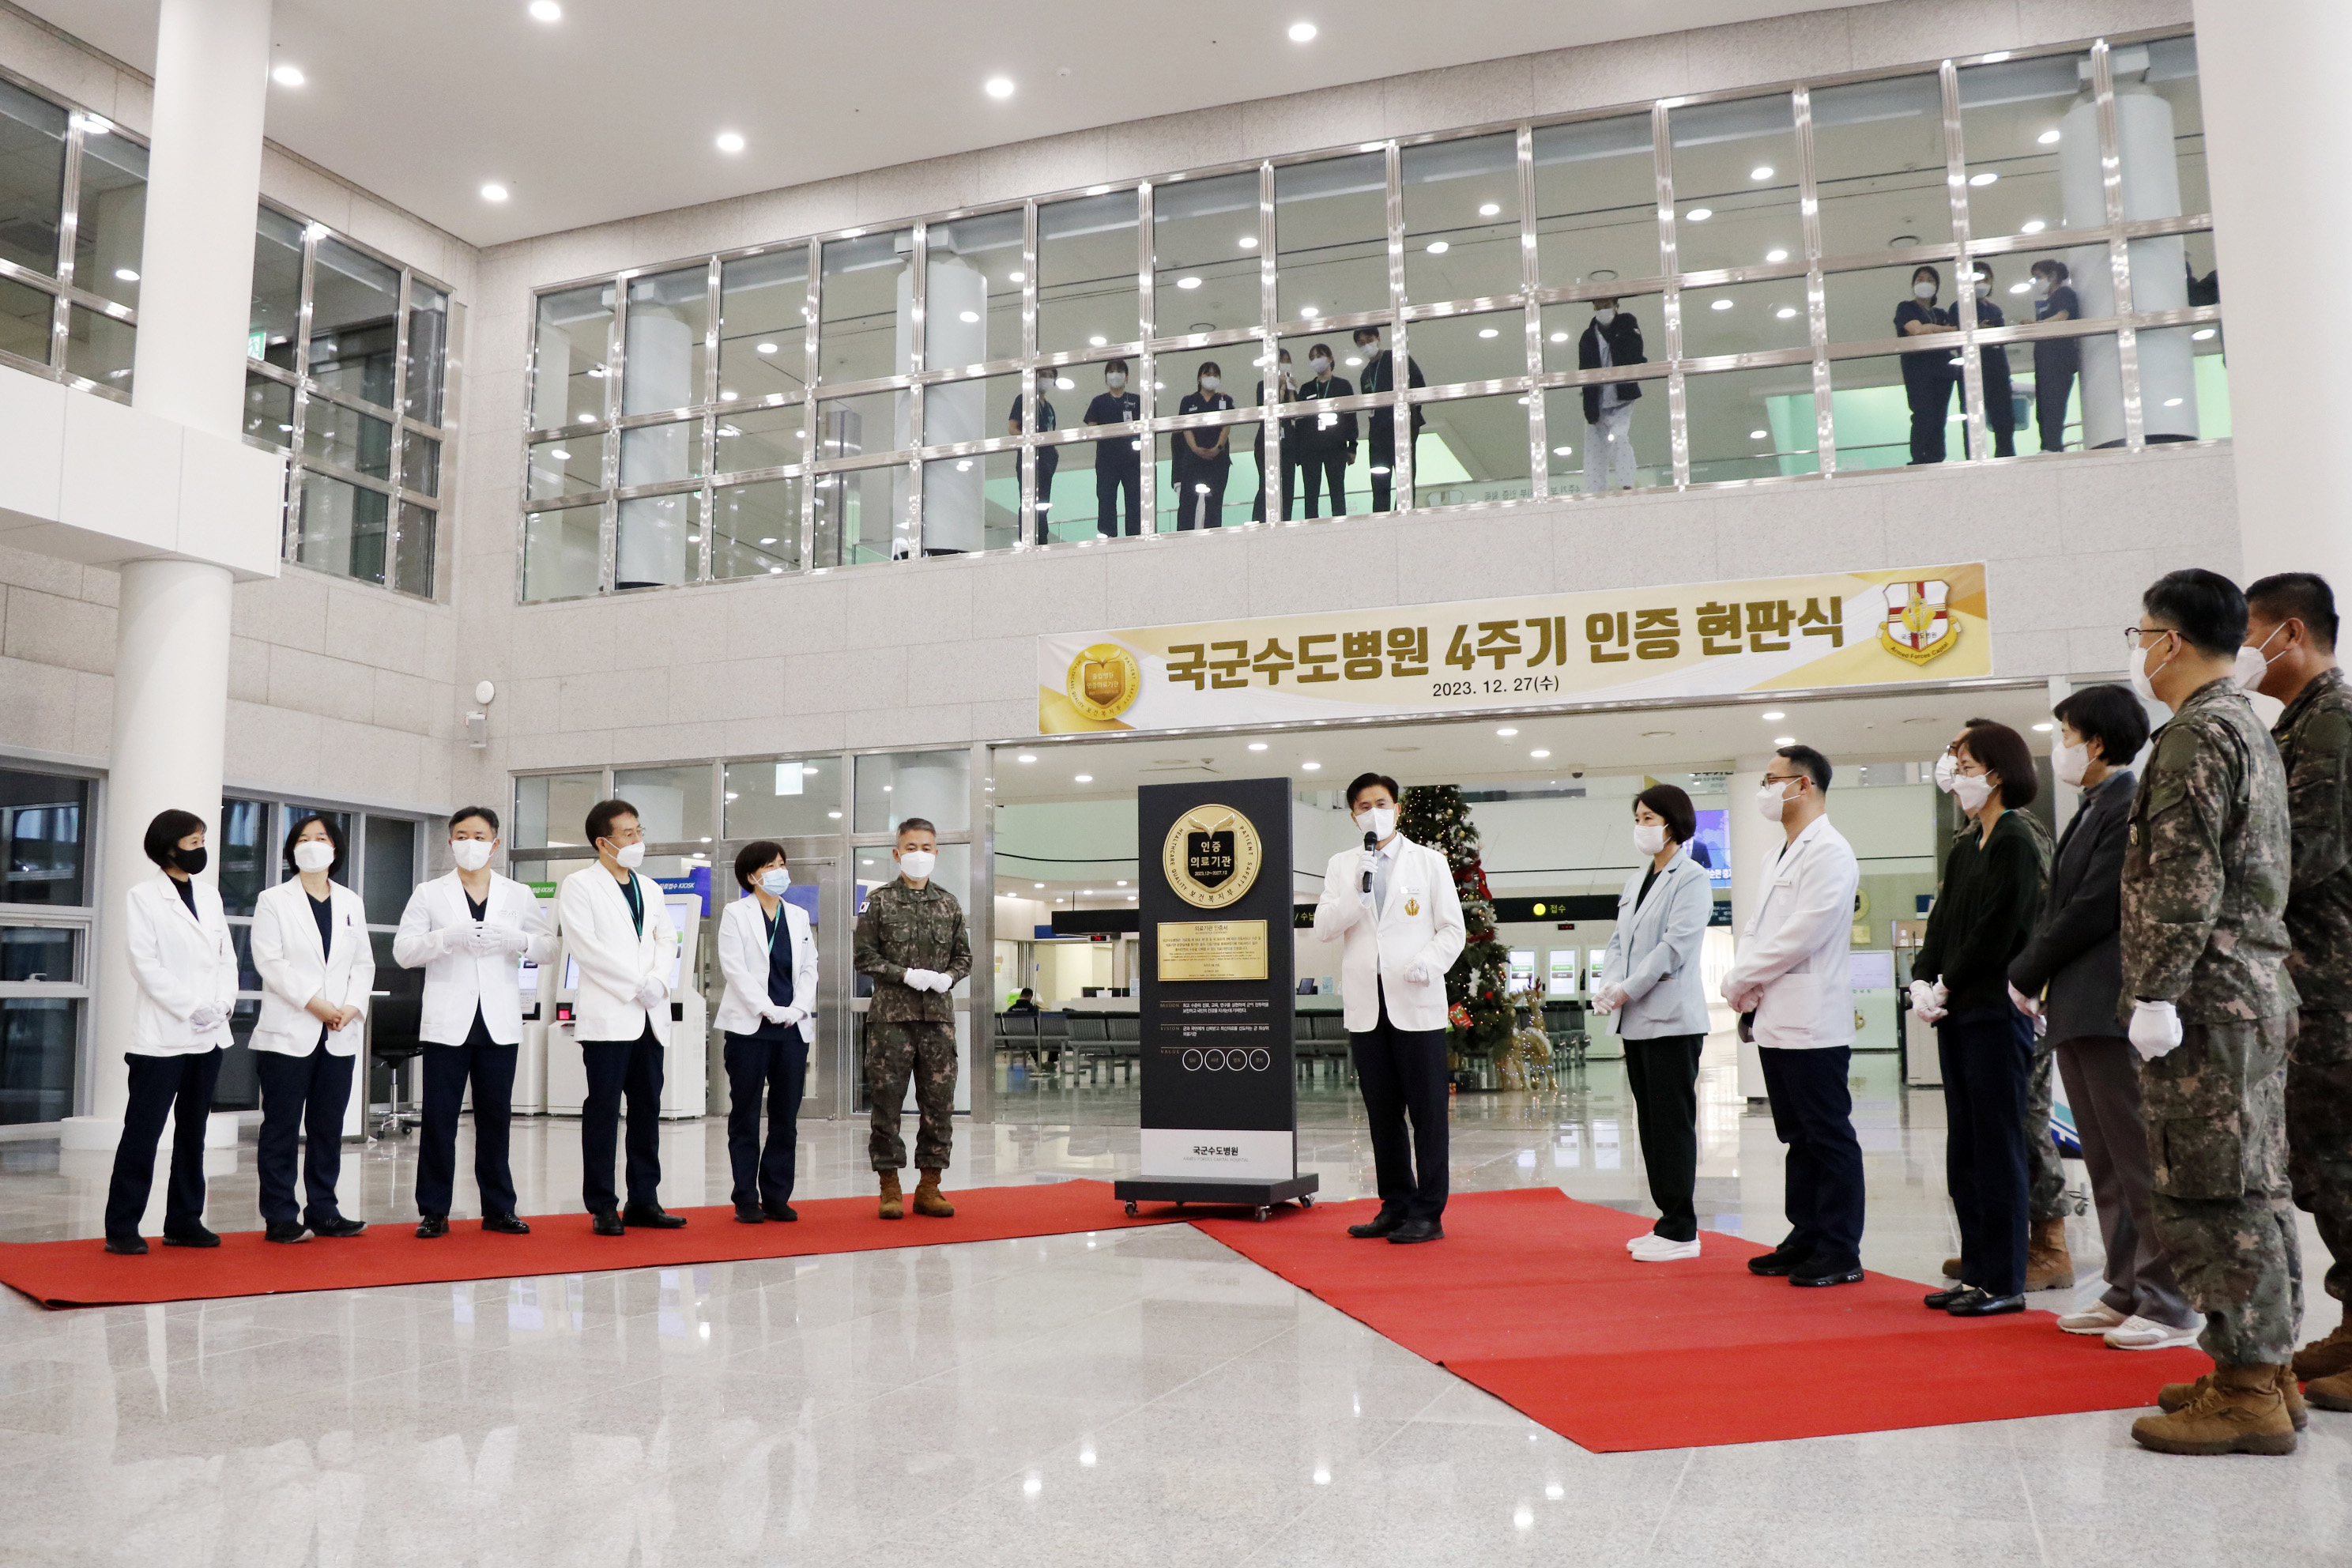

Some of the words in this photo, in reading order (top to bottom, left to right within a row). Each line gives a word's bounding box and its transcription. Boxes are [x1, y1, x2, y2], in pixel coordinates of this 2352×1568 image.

[1166, 626, 1430, 692] 국군수도병원
[1445, 616, 1566, 673] 4주기
[1585, 607, 1680, 662] 인증
[1696, 594, 1844, 654] 현판식
[1891, 646, 1909, 658] Armed
[1932, 642, 1948, 655] Capital
[1433, 681, 1476, 696] 2023.
[1483, 679, 1507, 693] 12.
[1513, 675, 1559, 693] 27(수)
[1170, 828, 1184, 865] HEALTHCARE
[1200, 840, 1221, 853] 인증
[1239, 825, 1253, 856] PATIENT
[1190, 856, 1231, 868] 의료기관
[1171, 868, 1188, 891] QUALITY
[1237, 861, 1253, 888] SAFETY
[1189, 888, 1234, 903] 보건복지부
[1550, 904, 1566, 914] 접수
[1193, 1146, 1238, 1156] 국군수도병원
